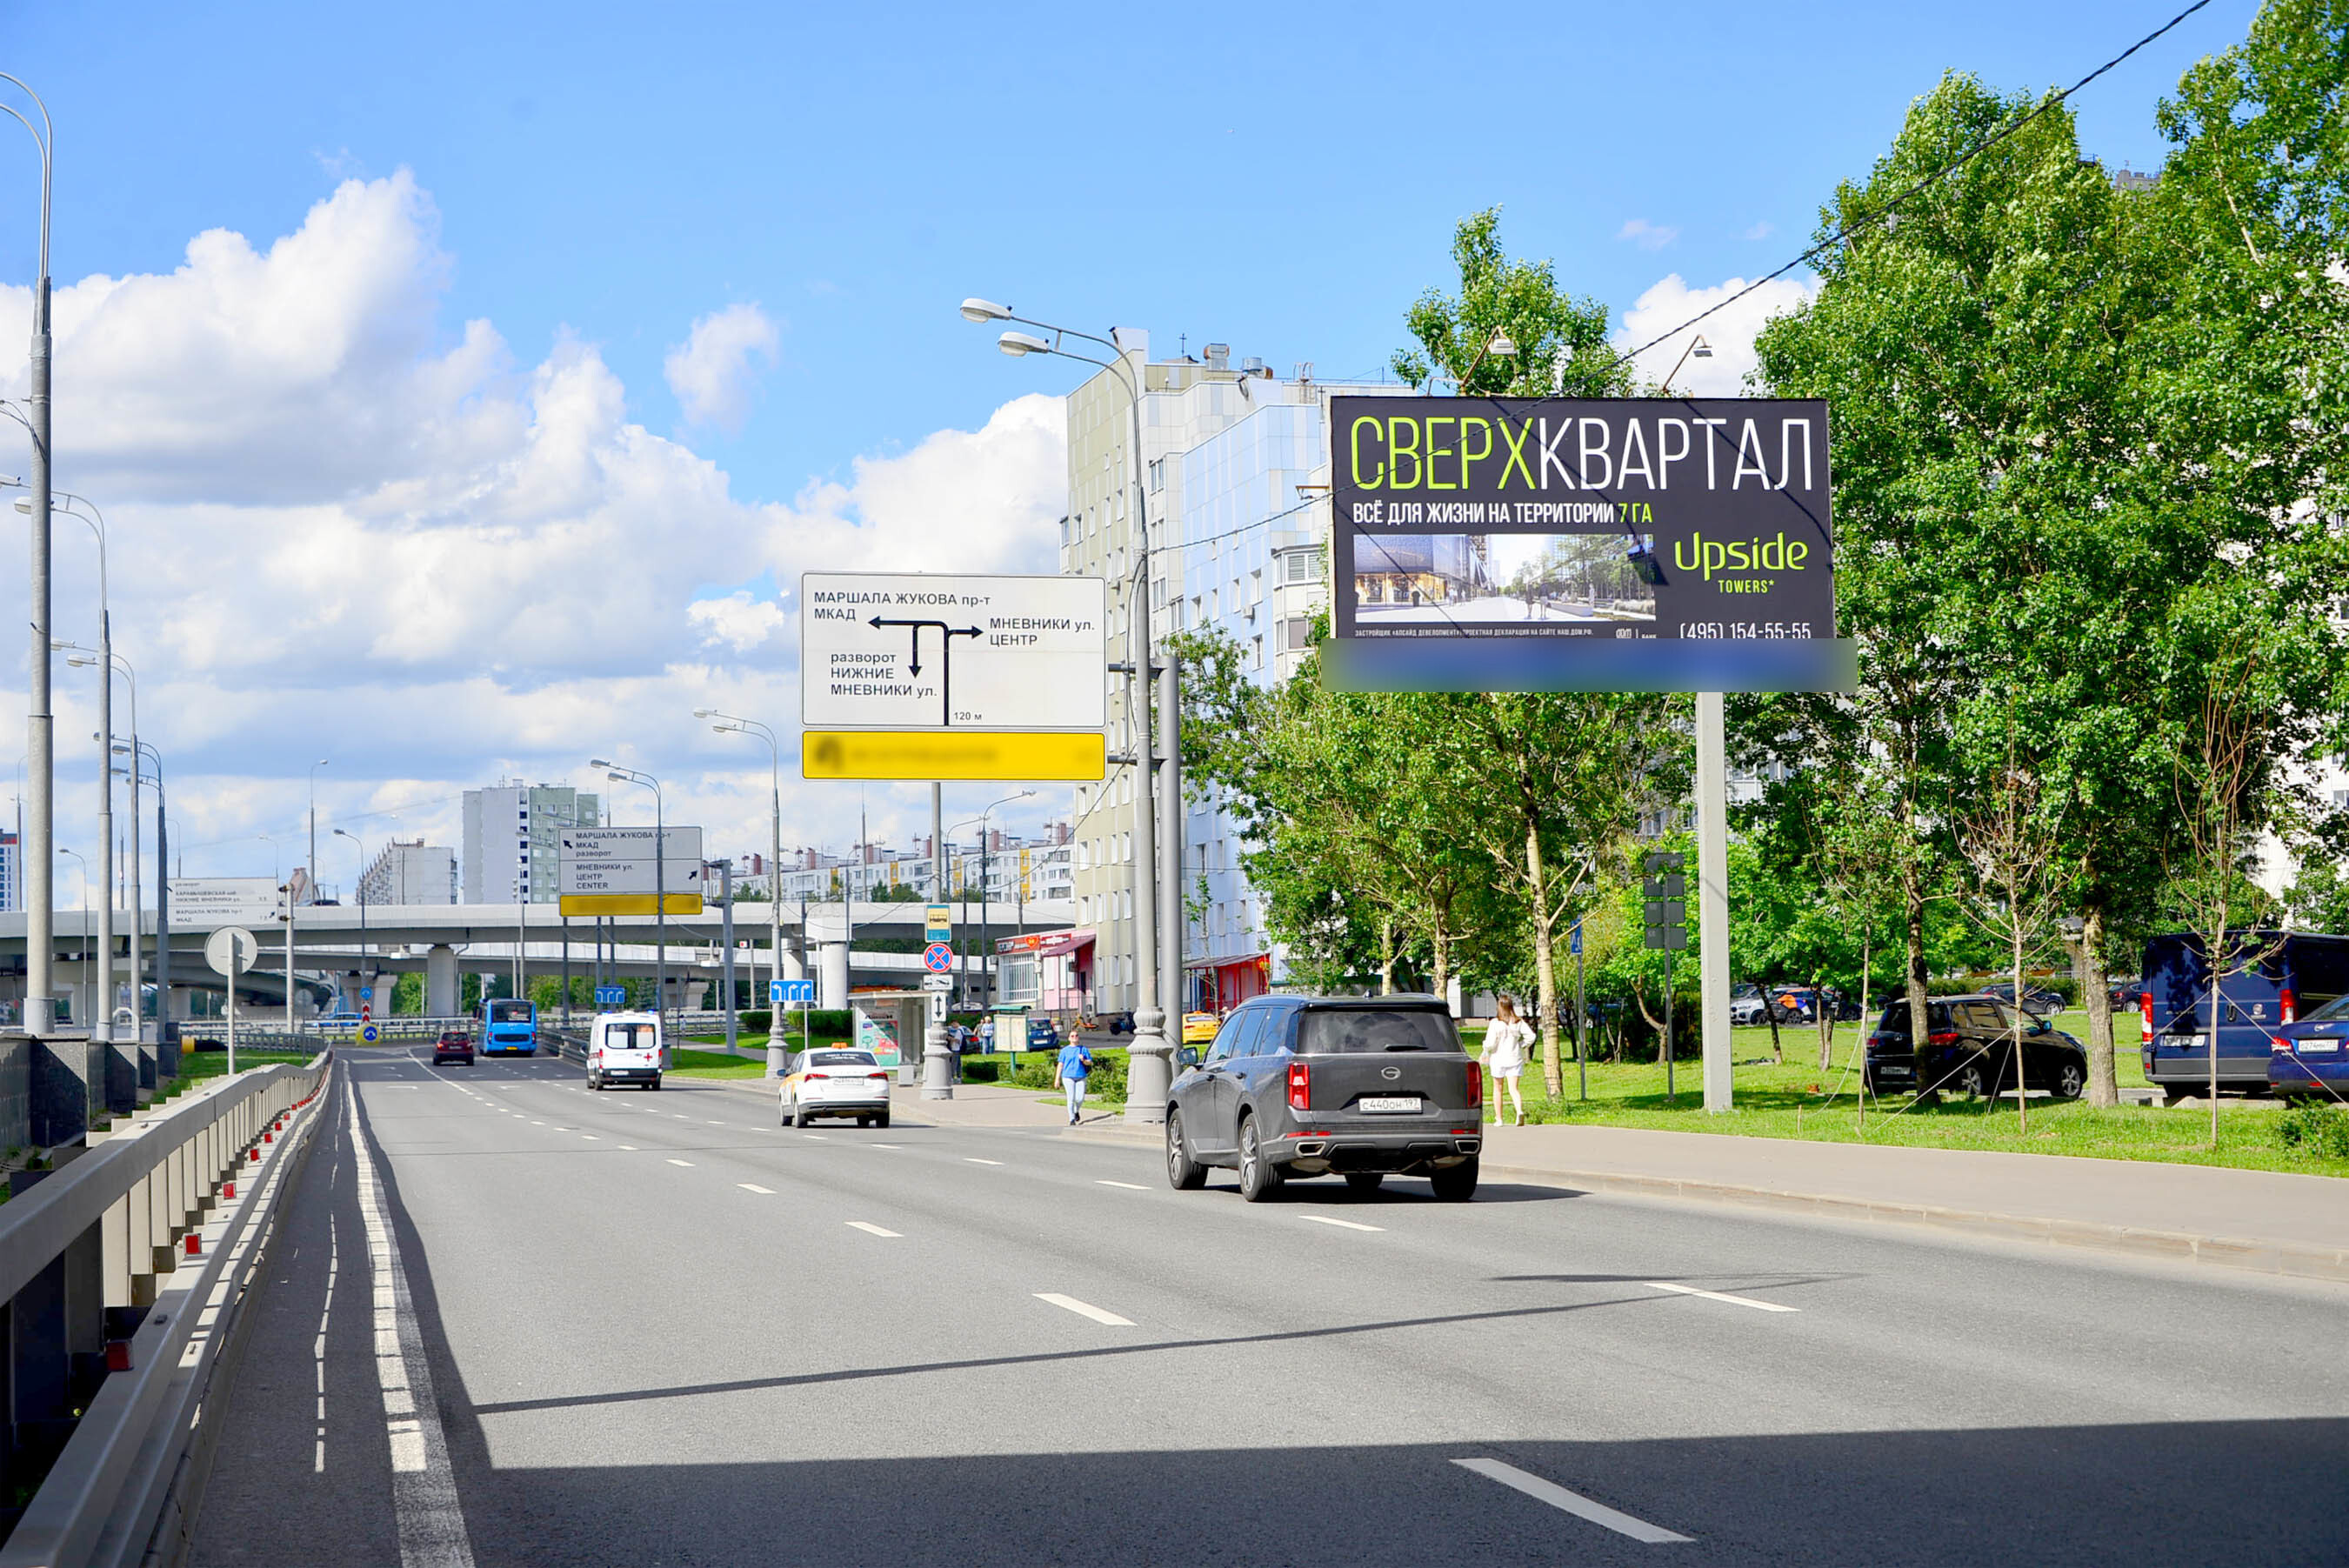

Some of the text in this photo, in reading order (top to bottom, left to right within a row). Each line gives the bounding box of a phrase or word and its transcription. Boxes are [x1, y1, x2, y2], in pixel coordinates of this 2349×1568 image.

[1351, 416, 1812, 491] СВЕРХКВАРТАЛ
[1352, 499, 1653, 524] ВСЁ ДЛЯ ЖИЗНИ НА ТЕРРИТОРИИ 7 ГА
[1674, 531, 1808, 581] Upside
[814, 592, 991, 608] МАРШАЛА ЖУКОВА пр-т
[814, 608, 856, 622] МКАД
[990, 617, 1094, 632] МНЕВНИКИ ул.
[1679, 623, 1812, 638] (495) 154-55-55
[990, 634, 1038, 647] ЦЕНТР
[831, 652, 896, 664] разворот
[831, 668, 894, 678] НИЖНИЕ
[831, 684, 937, 698] МНЕВНИКИ ул.
